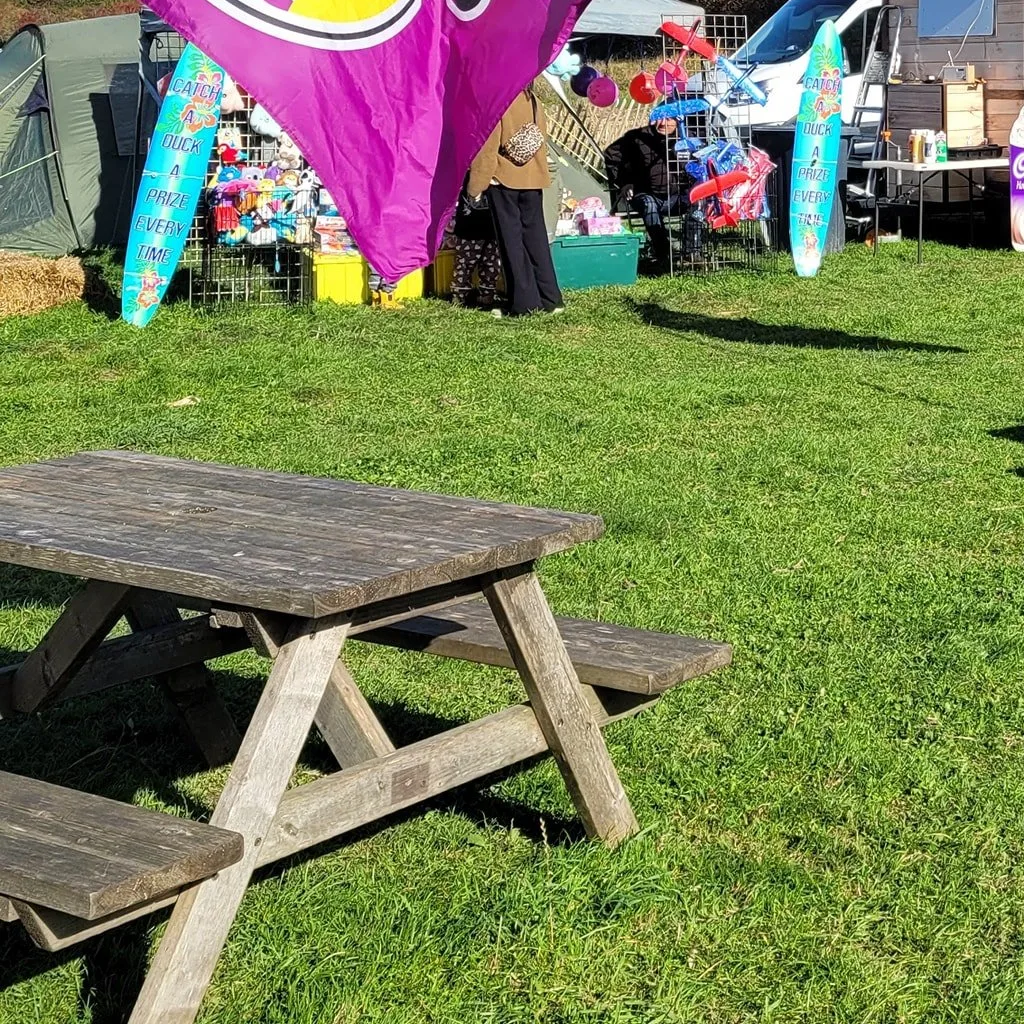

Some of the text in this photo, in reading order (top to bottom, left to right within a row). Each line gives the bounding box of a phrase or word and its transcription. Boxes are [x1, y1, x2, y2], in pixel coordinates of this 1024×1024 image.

[172, 78, 223, 101] CATCH
[804, 76, 842, 92] CATCH
[816, 101, 826, 113] A
[183, 109, 194, 124] A
[803, 122, 832, 137] DUCK
[162, 134, 203, 155] DUCK
[811, 145, 820, 159] A
[170, 164, 181, 179] A
[797, 167, 830, 182] PRIZE
[145, 188, 190, 210] PRIZE
[793, 190, 831, 204] EVERY
[135, 215, 186, 237] EVERY
[798, 212, 824, 227] TIME
[136, 244, 173, 264] TIME
